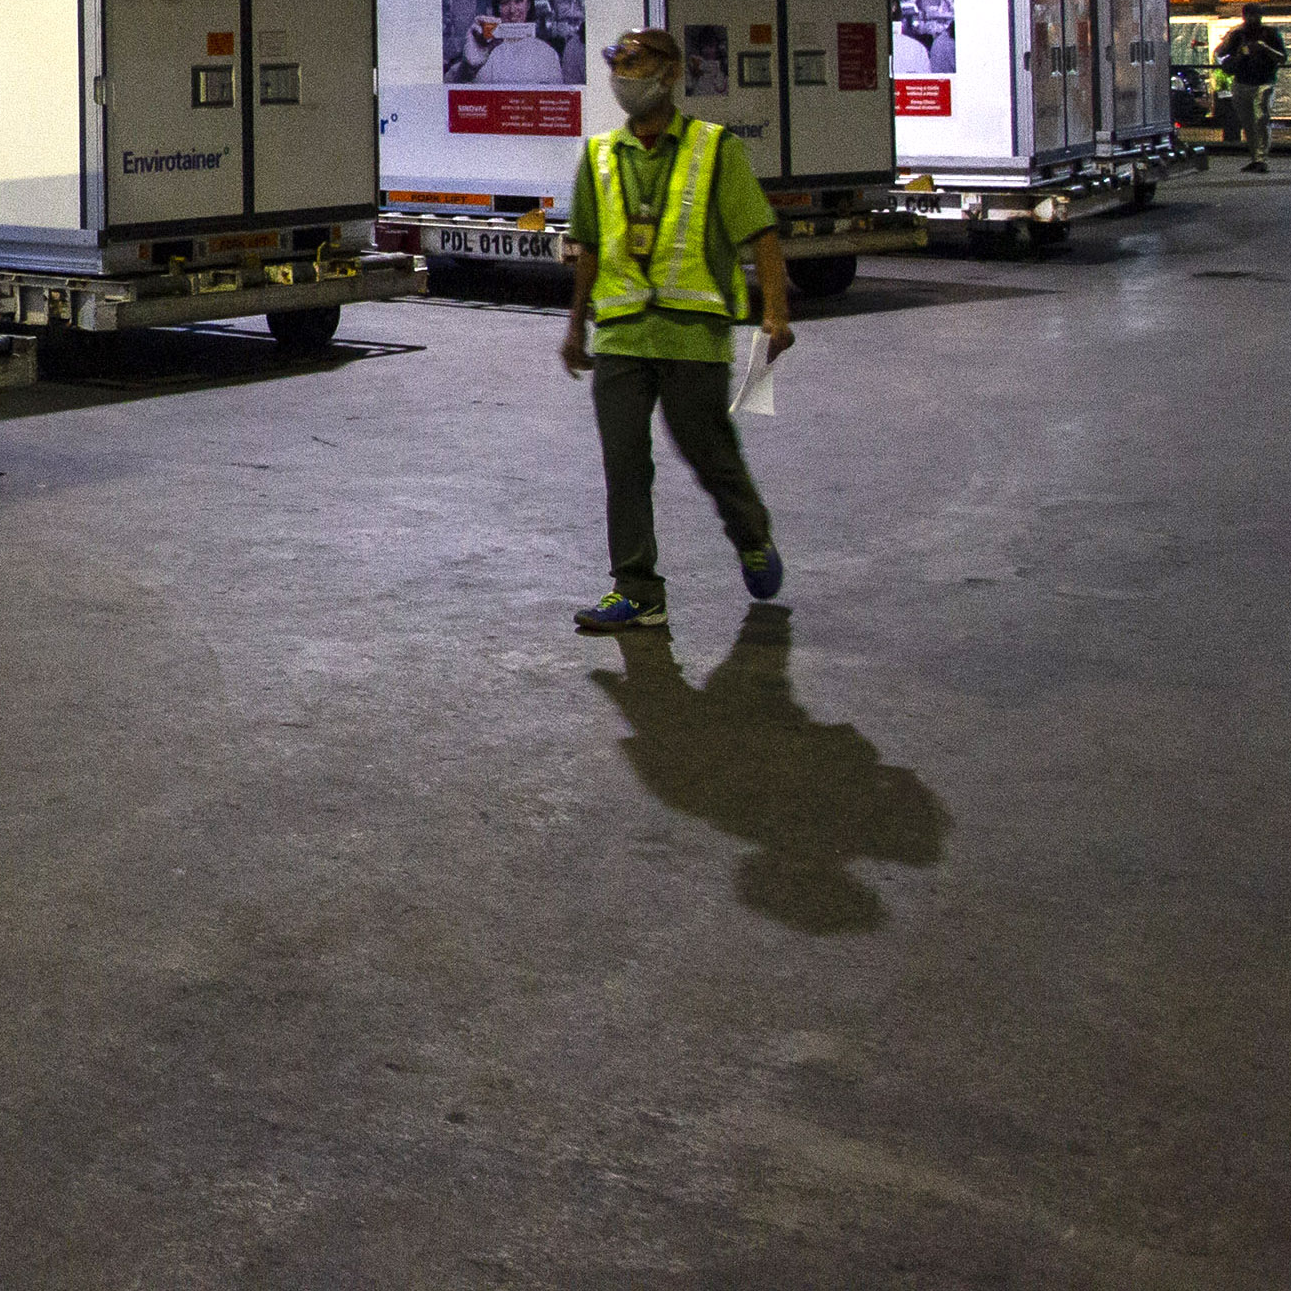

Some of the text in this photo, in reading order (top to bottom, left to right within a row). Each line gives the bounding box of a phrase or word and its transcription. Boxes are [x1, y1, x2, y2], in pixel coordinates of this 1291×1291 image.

[441, 230, 553, 257] PDL 016 CGK
